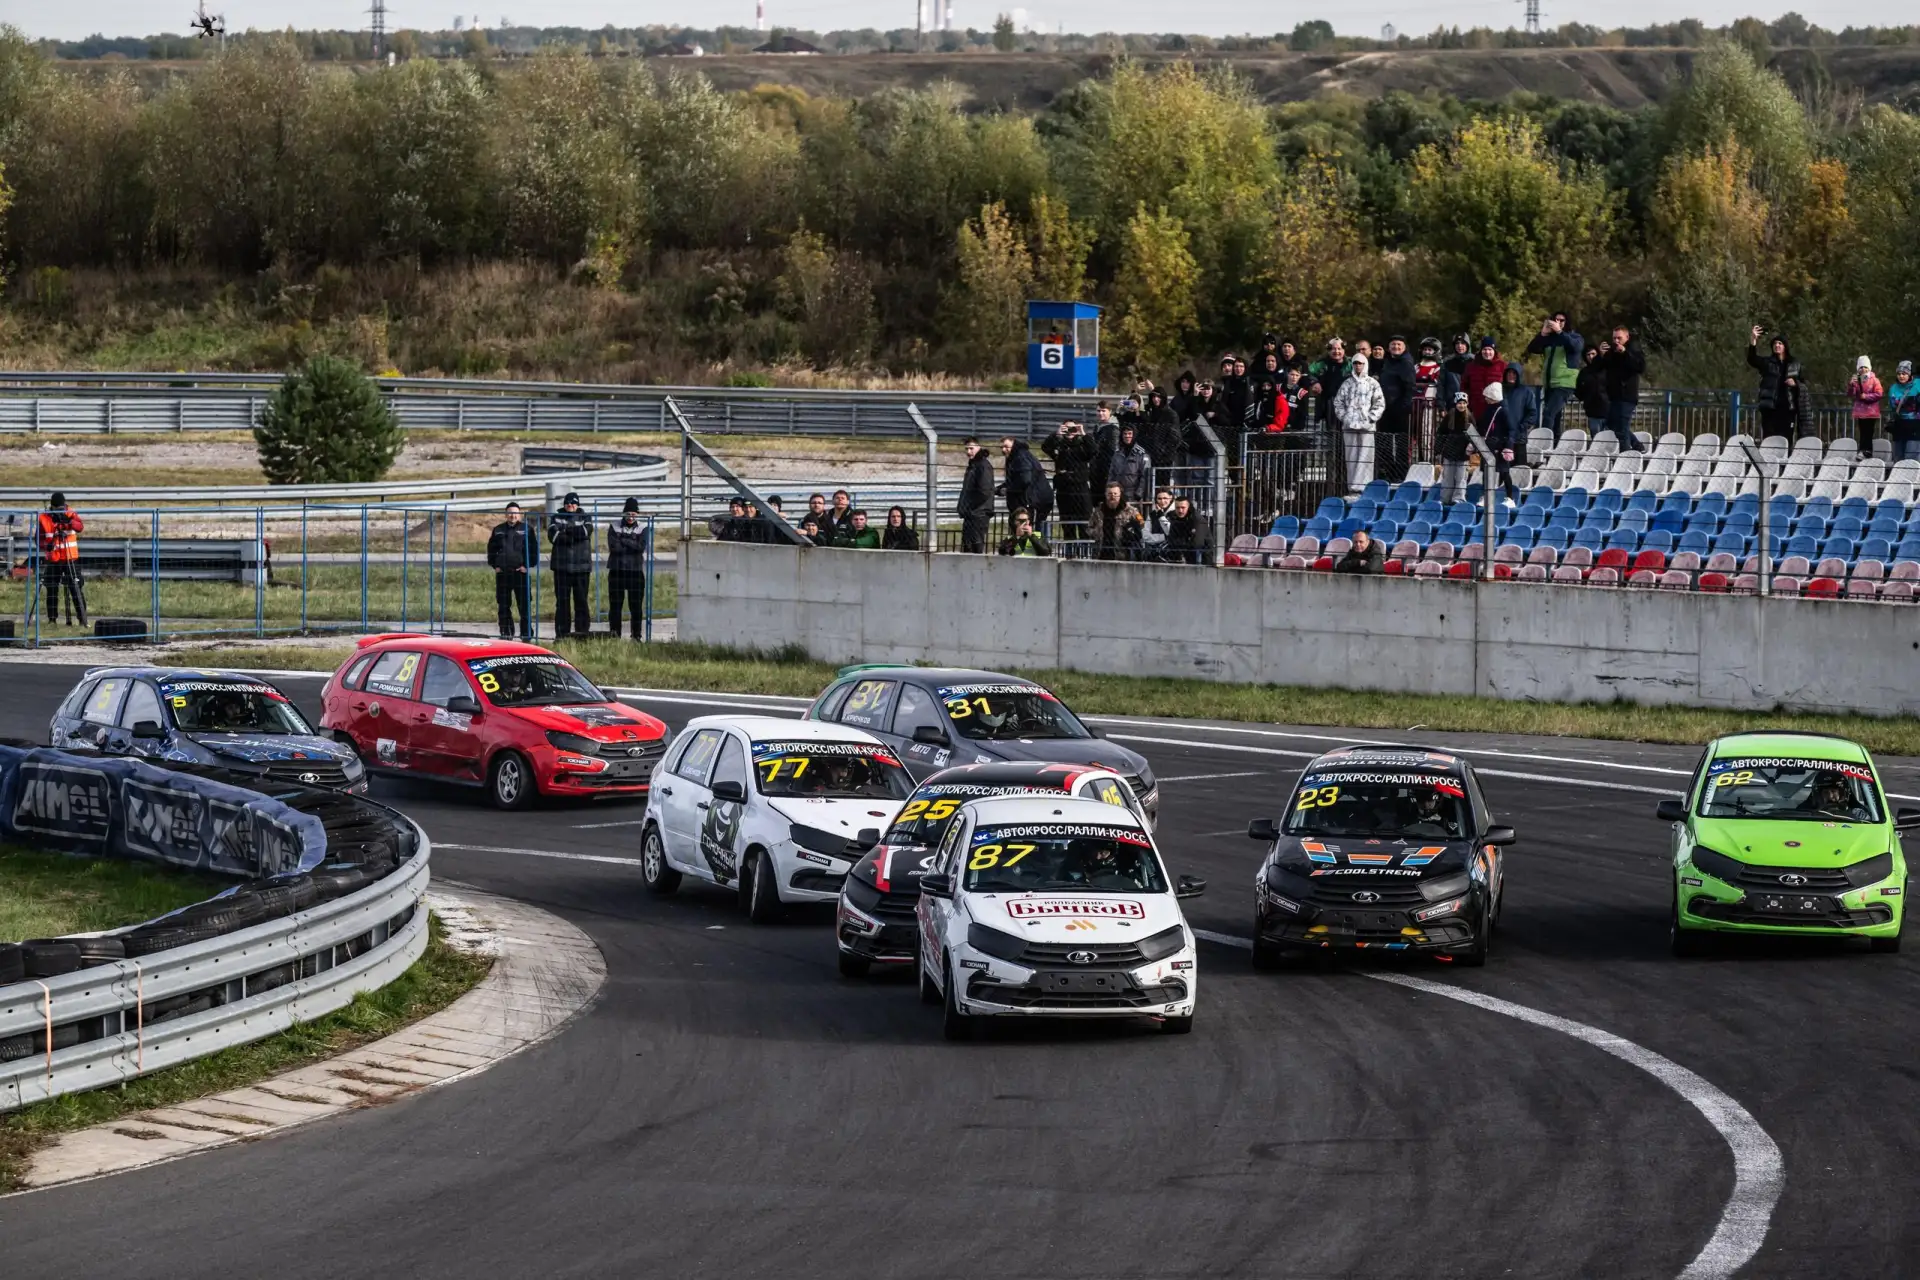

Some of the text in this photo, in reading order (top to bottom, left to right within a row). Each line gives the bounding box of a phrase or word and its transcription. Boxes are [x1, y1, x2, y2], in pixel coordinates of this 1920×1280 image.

[1044, 348, 1061, 365] 6
[398, 655, 416, 682] 8
[478, 673, 500, 694] 8
[97, 683, 115, 710] 5
[173, 696, 187, 708] 5
[851, 681, 886, 709] 31
[947, 697, 992, 719] 31
[688, 735, 718, 764] 77
[768, 743, 893, 758] АВТОКРОСС/РАЛЛИ-КРОСС
[909, 744, 931, 755] АВТО
[935, 751, 948, 763] 31
[759, 757, 810, 782] 77
[1731, 758, 1872, 778] АВТОКРОСС/РАЛЛИ-КРОСС
[1318, 773, 1462, 788] АВТОКРОСС/РАЛЛИ-КРОСС
[1716, 771, 1753, 787] 62
[1297, 786, 1339, 811] 23
[895, 800, 961, 824] 25
[997, 825, 1147, 843] АВТОКРОСС/РАЛЛИ-КРОСС
[968, 844, 1036, 871] 87
[1334, 868, 1422, 877] COOLSTREAM
